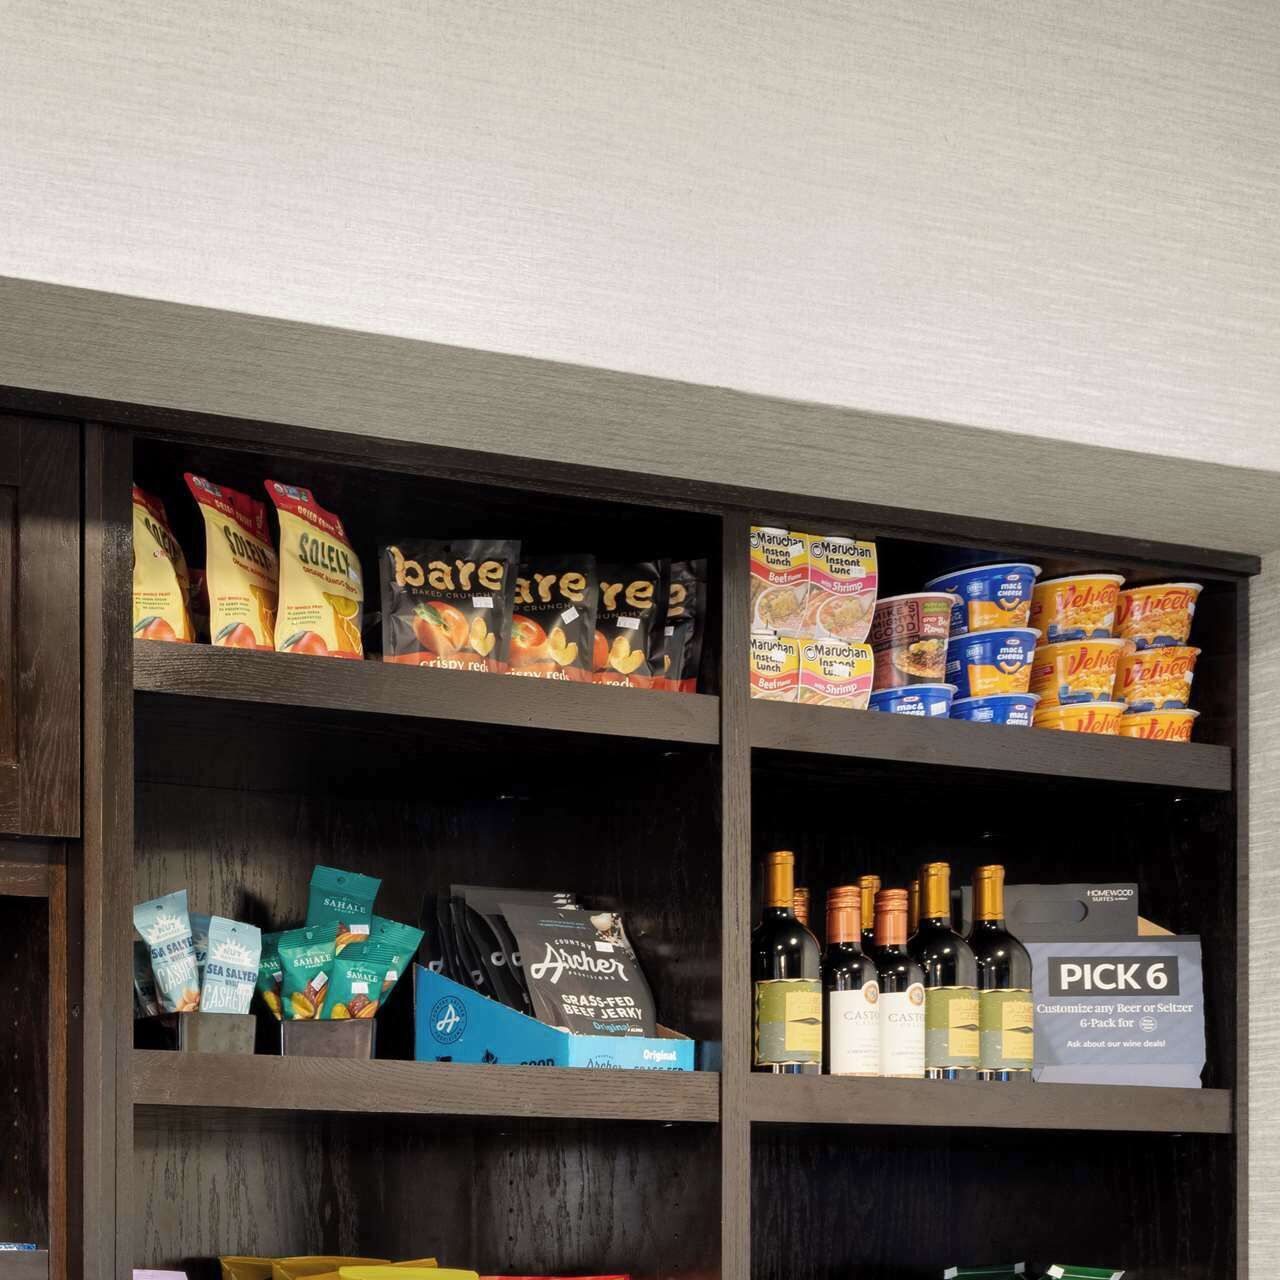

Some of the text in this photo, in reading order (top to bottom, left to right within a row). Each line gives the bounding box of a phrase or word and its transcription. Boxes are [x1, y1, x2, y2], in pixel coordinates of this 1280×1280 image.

[224, 525, 271, 569] SOLELY
[756, 532, 804, 549] Maruchan
[299, 532, 351, 577] SOLELY
[821, 541, 872, 558] Maruchan
[389, 545, 505, 591] bare
[826, 555, 860, 567] Instant
[815, 644, 868, 659] Maruchan
[1087, 889, 1134, 897] HOMEWOOD
[530, 942, 629, 985] Archer
[1059, 962, 1168, 991] PICK 6
[561, 994, 635, 1008] GRASS-FED
[1036, 1002, 1194, 1015] Customize any Beer or Seltzer
[562, 1004, 642, 1020] BEEF JERKY
[1079, 1018, 1135, 1029] 6-Pack for
[1066, 1039, 1166, 1048] Ask about our wine deals!
[643, 1049, 677, 1062] Original
